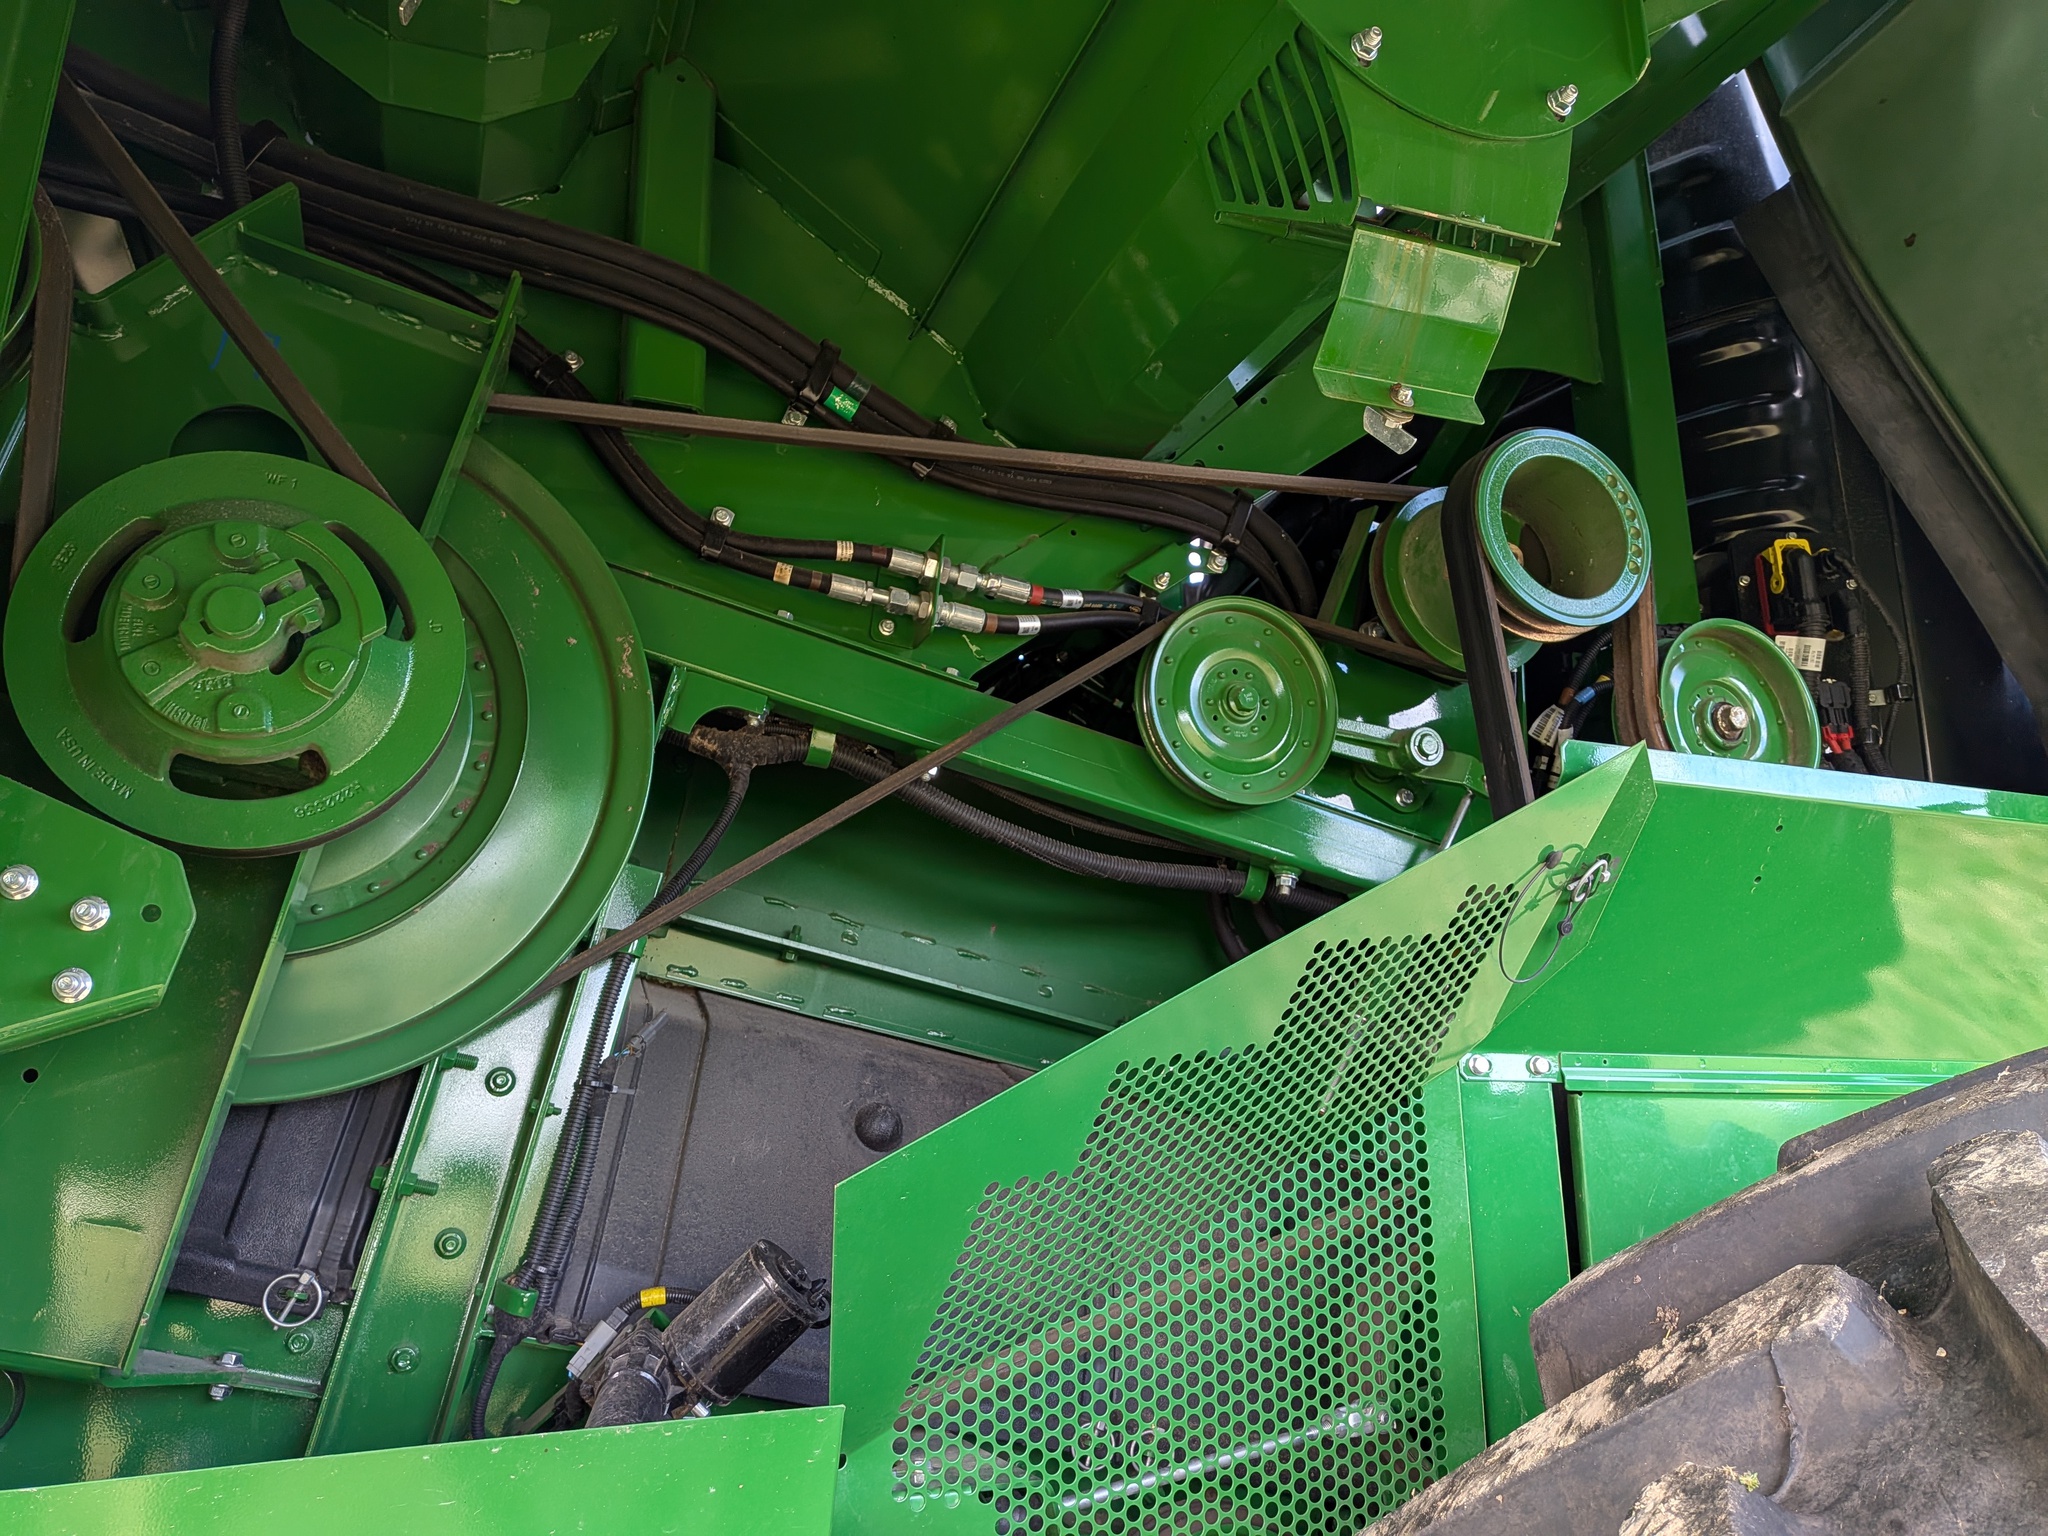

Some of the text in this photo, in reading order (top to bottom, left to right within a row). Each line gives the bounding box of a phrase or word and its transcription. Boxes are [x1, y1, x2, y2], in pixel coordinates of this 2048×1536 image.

[55, 726, 135, 800] MADE IN USA
